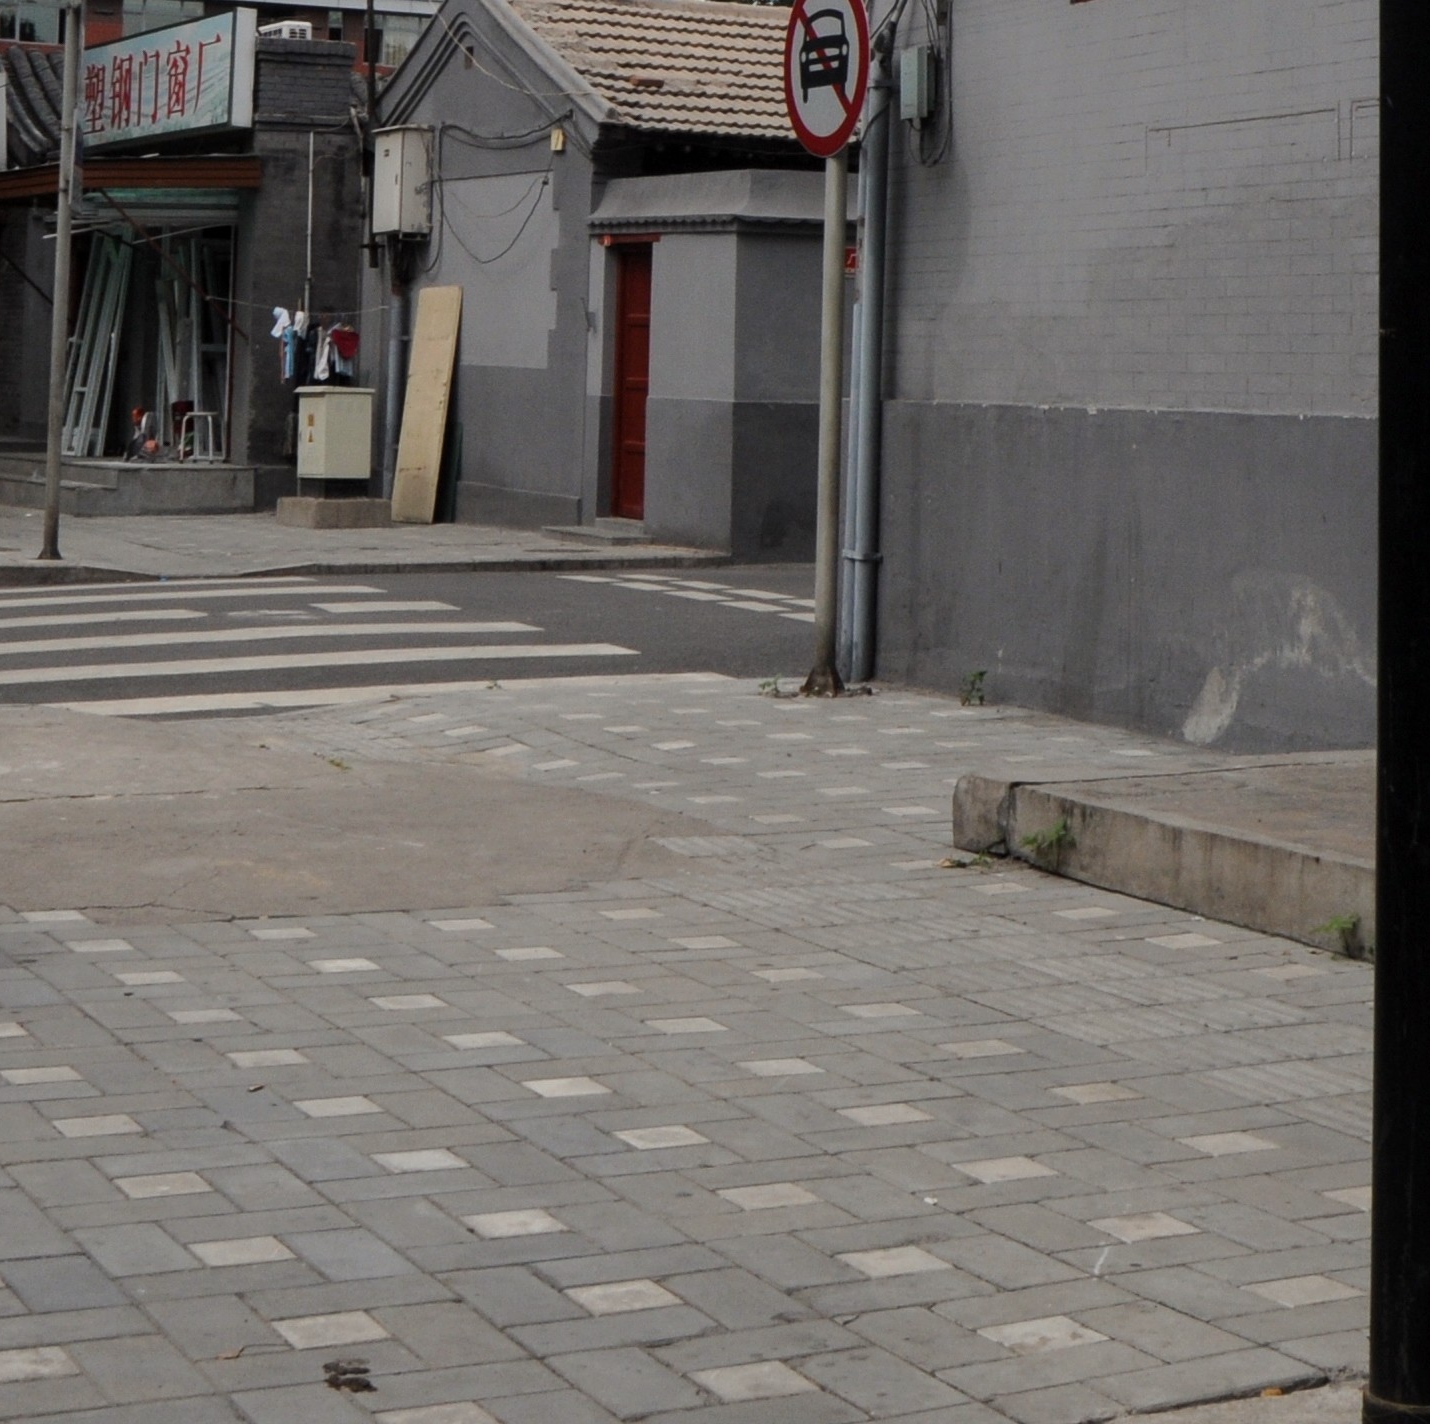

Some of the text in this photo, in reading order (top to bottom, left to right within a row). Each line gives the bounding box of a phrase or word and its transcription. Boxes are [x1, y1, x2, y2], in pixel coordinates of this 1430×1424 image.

[83, 33, 222, 135] 塑钢门窗厂
